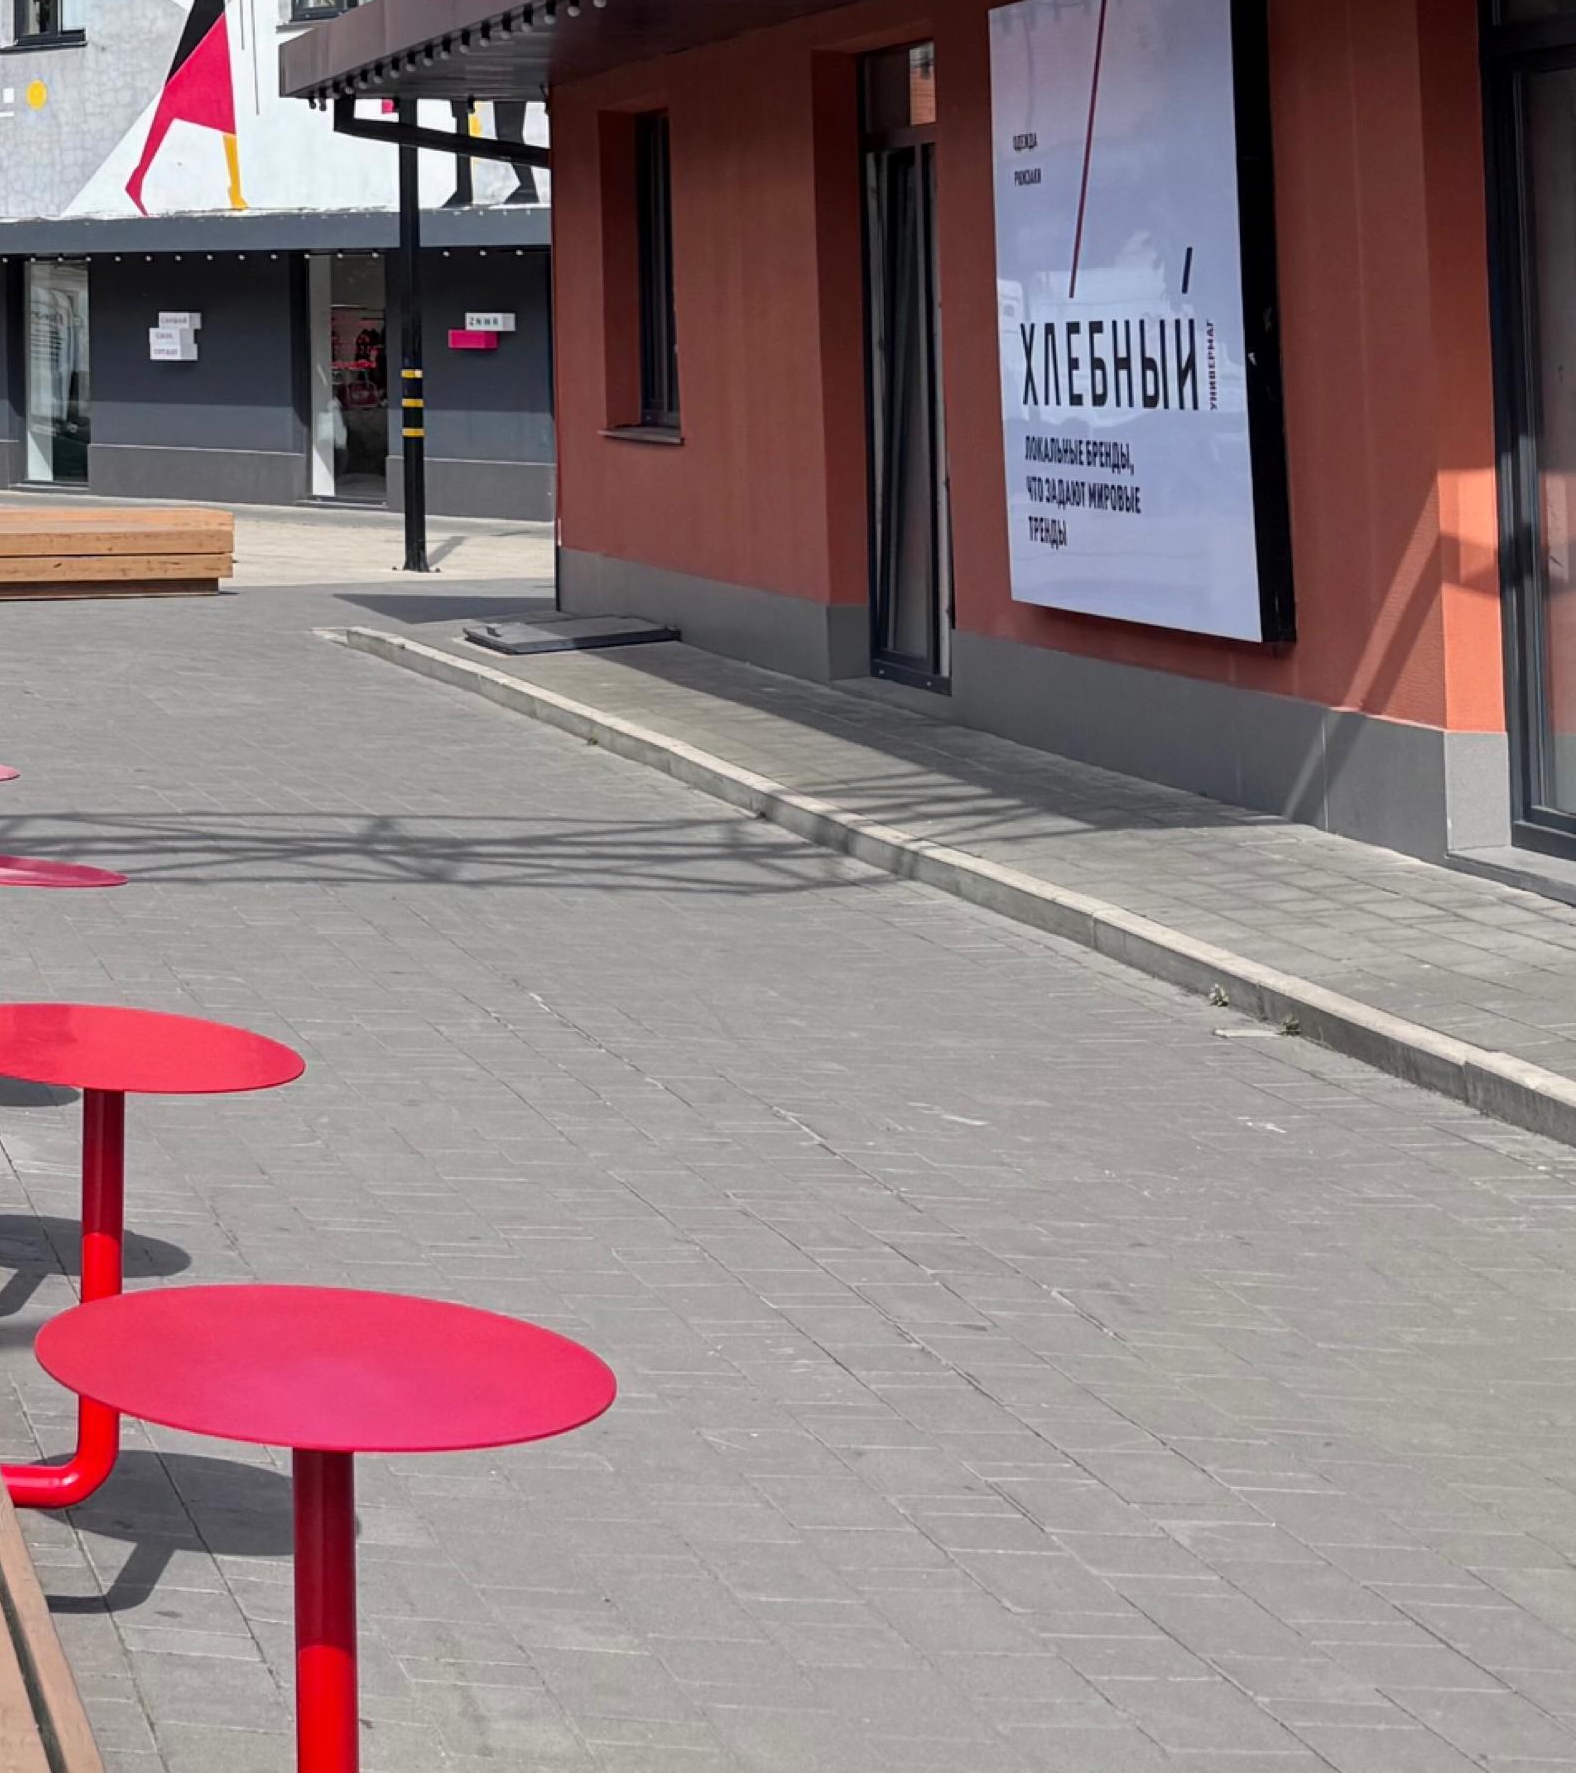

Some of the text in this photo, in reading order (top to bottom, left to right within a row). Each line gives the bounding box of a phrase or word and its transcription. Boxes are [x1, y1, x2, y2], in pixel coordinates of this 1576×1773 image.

[1020, 318, 1199, 410] ХЛЕБНЫЙ
[1025, 435, 1135, 475] ЛОКАЛЬНЫЕ БРЕНДЫ,
[1026, 475, 1141, 514] ЧТО ЗАДАЮТ МИРОВЫЕ
[1028, 516, 1068, 550] ТРЕНДЫ
